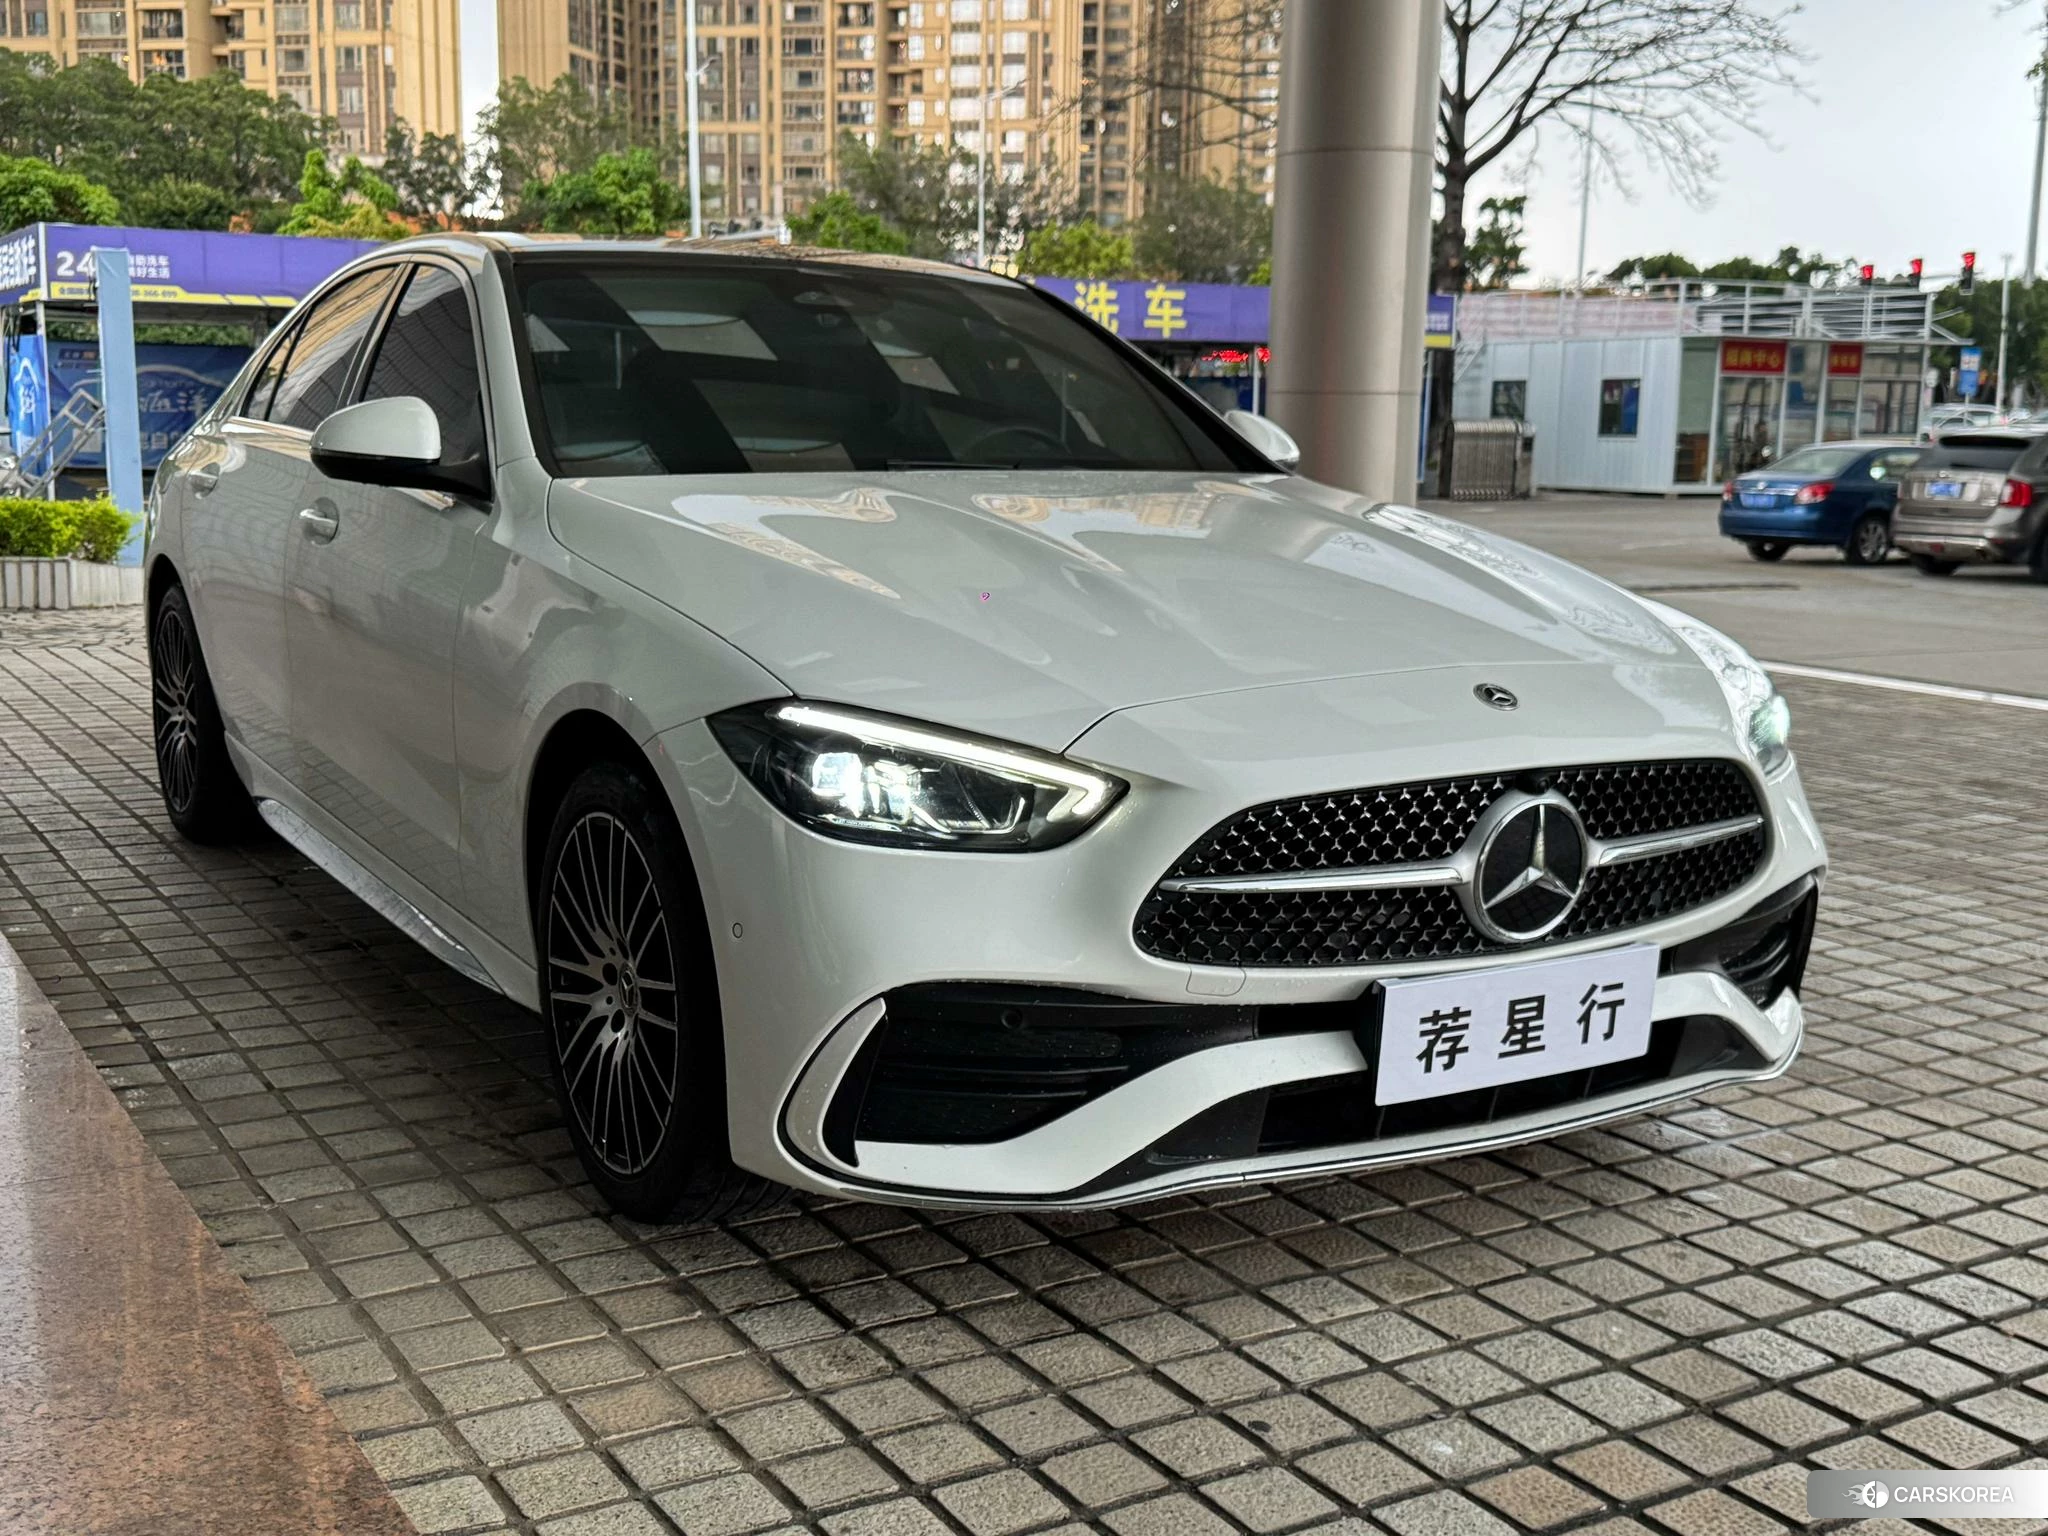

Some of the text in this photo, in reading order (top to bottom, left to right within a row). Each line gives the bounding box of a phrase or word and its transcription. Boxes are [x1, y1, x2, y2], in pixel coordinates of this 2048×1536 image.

[56, 250, 96, 277] 24
[1074, 280, 1188, 339] 洗车
[1416, 982, 1626, 1074] 荐星行
